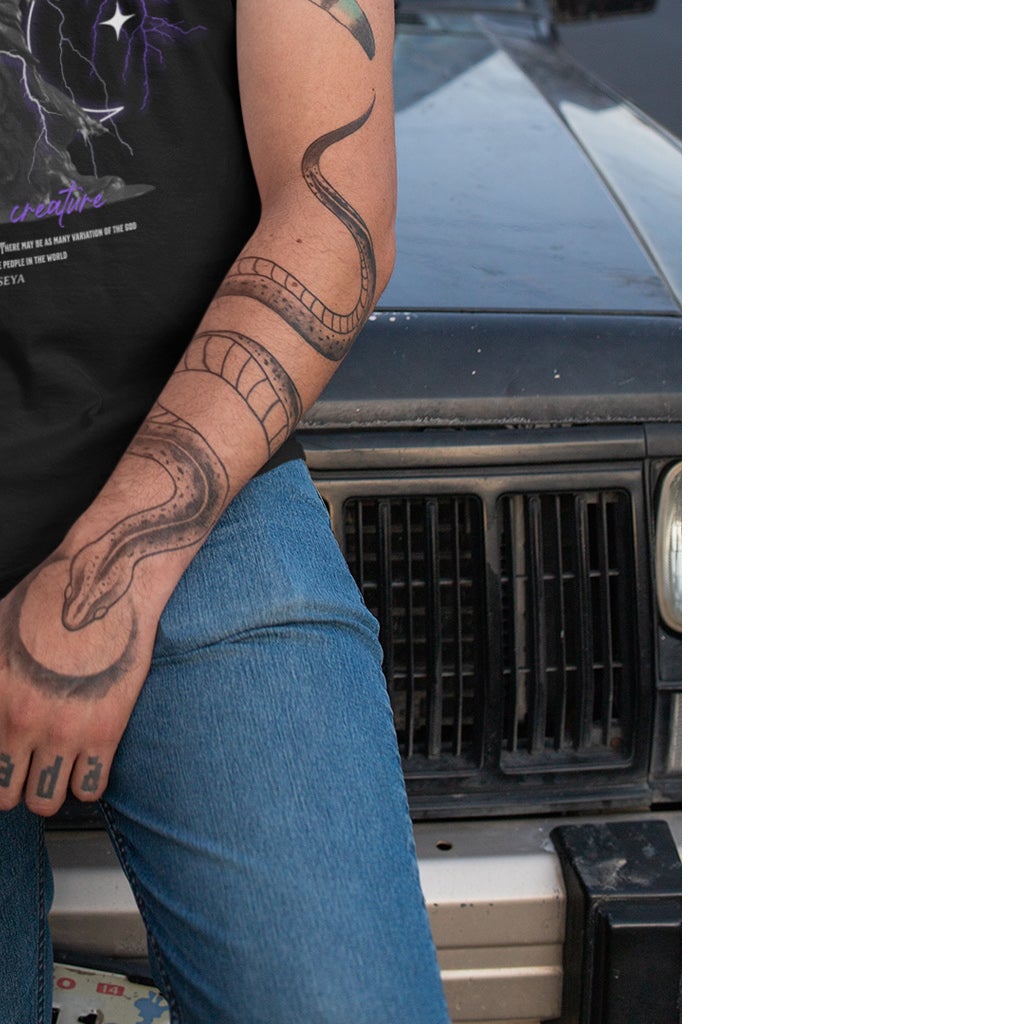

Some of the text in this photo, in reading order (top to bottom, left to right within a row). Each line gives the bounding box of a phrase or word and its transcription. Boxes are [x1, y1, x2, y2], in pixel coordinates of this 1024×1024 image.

[10, 180, 108, 228] creature
[21, 240, 34, 250] MAY
[35, 239, 44, 248] BE
[44, 238, 53, 247] AS
[53, 234, 71, 245] MANY
[71, 228, 103, 242] VARIATION
[103, 226, 112, 235] OF
[112, 223, 124, 234] THE
[124, 221, 137, 232] GOD
[3, 257, 25, 269] PEOPLE
[26, 256, 33, 266] IN
[34, 254, 46, 265] THE
[46, 251, 68, 262] WORLD
